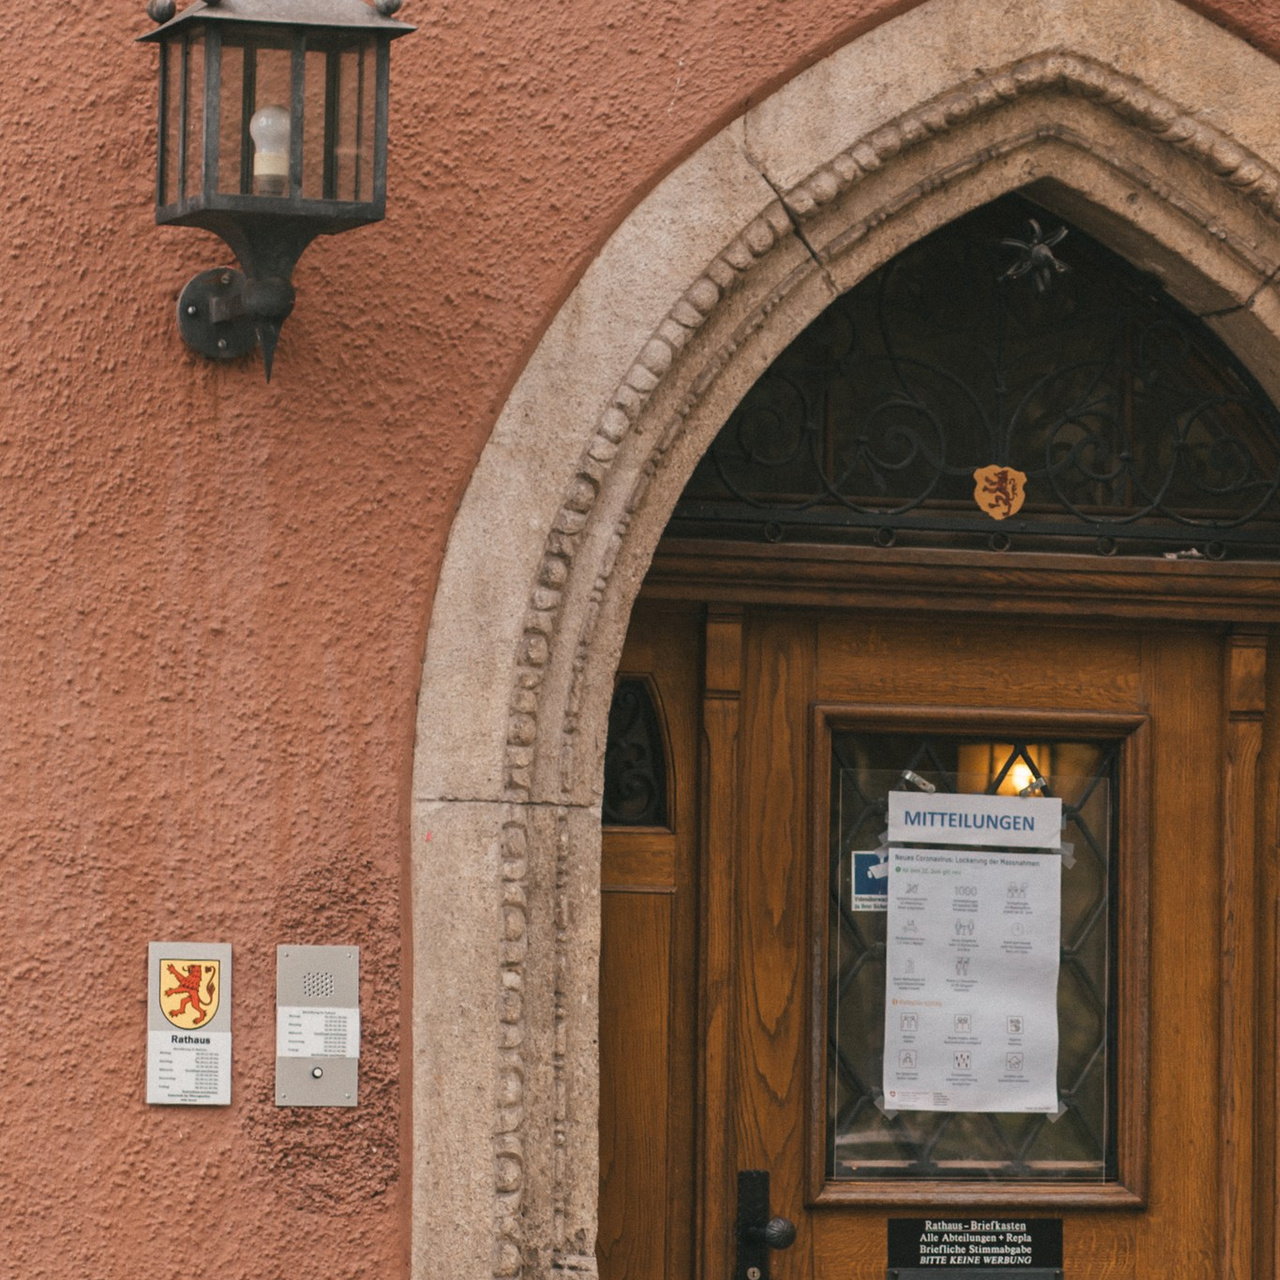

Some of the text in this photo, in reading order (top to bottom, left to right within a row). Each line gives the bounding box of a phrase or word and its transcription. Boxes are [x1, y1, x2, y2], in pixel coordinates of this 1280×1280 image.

[904, 810, 1035, 832] MITTEILUNGEN
[171, 1034, 211, 1045] Rathaus
[920, 1233, 939, 1242] Alle
[942, 1233, 997, 1244] Abteilungen
[1006, 1233, 1032, 1244] Repla
[920, 1244, 1032, 1255] Briefliche Stimmabgabe
[920, 1256, 1032, 1265] BITTE KEINE WERBUNG
